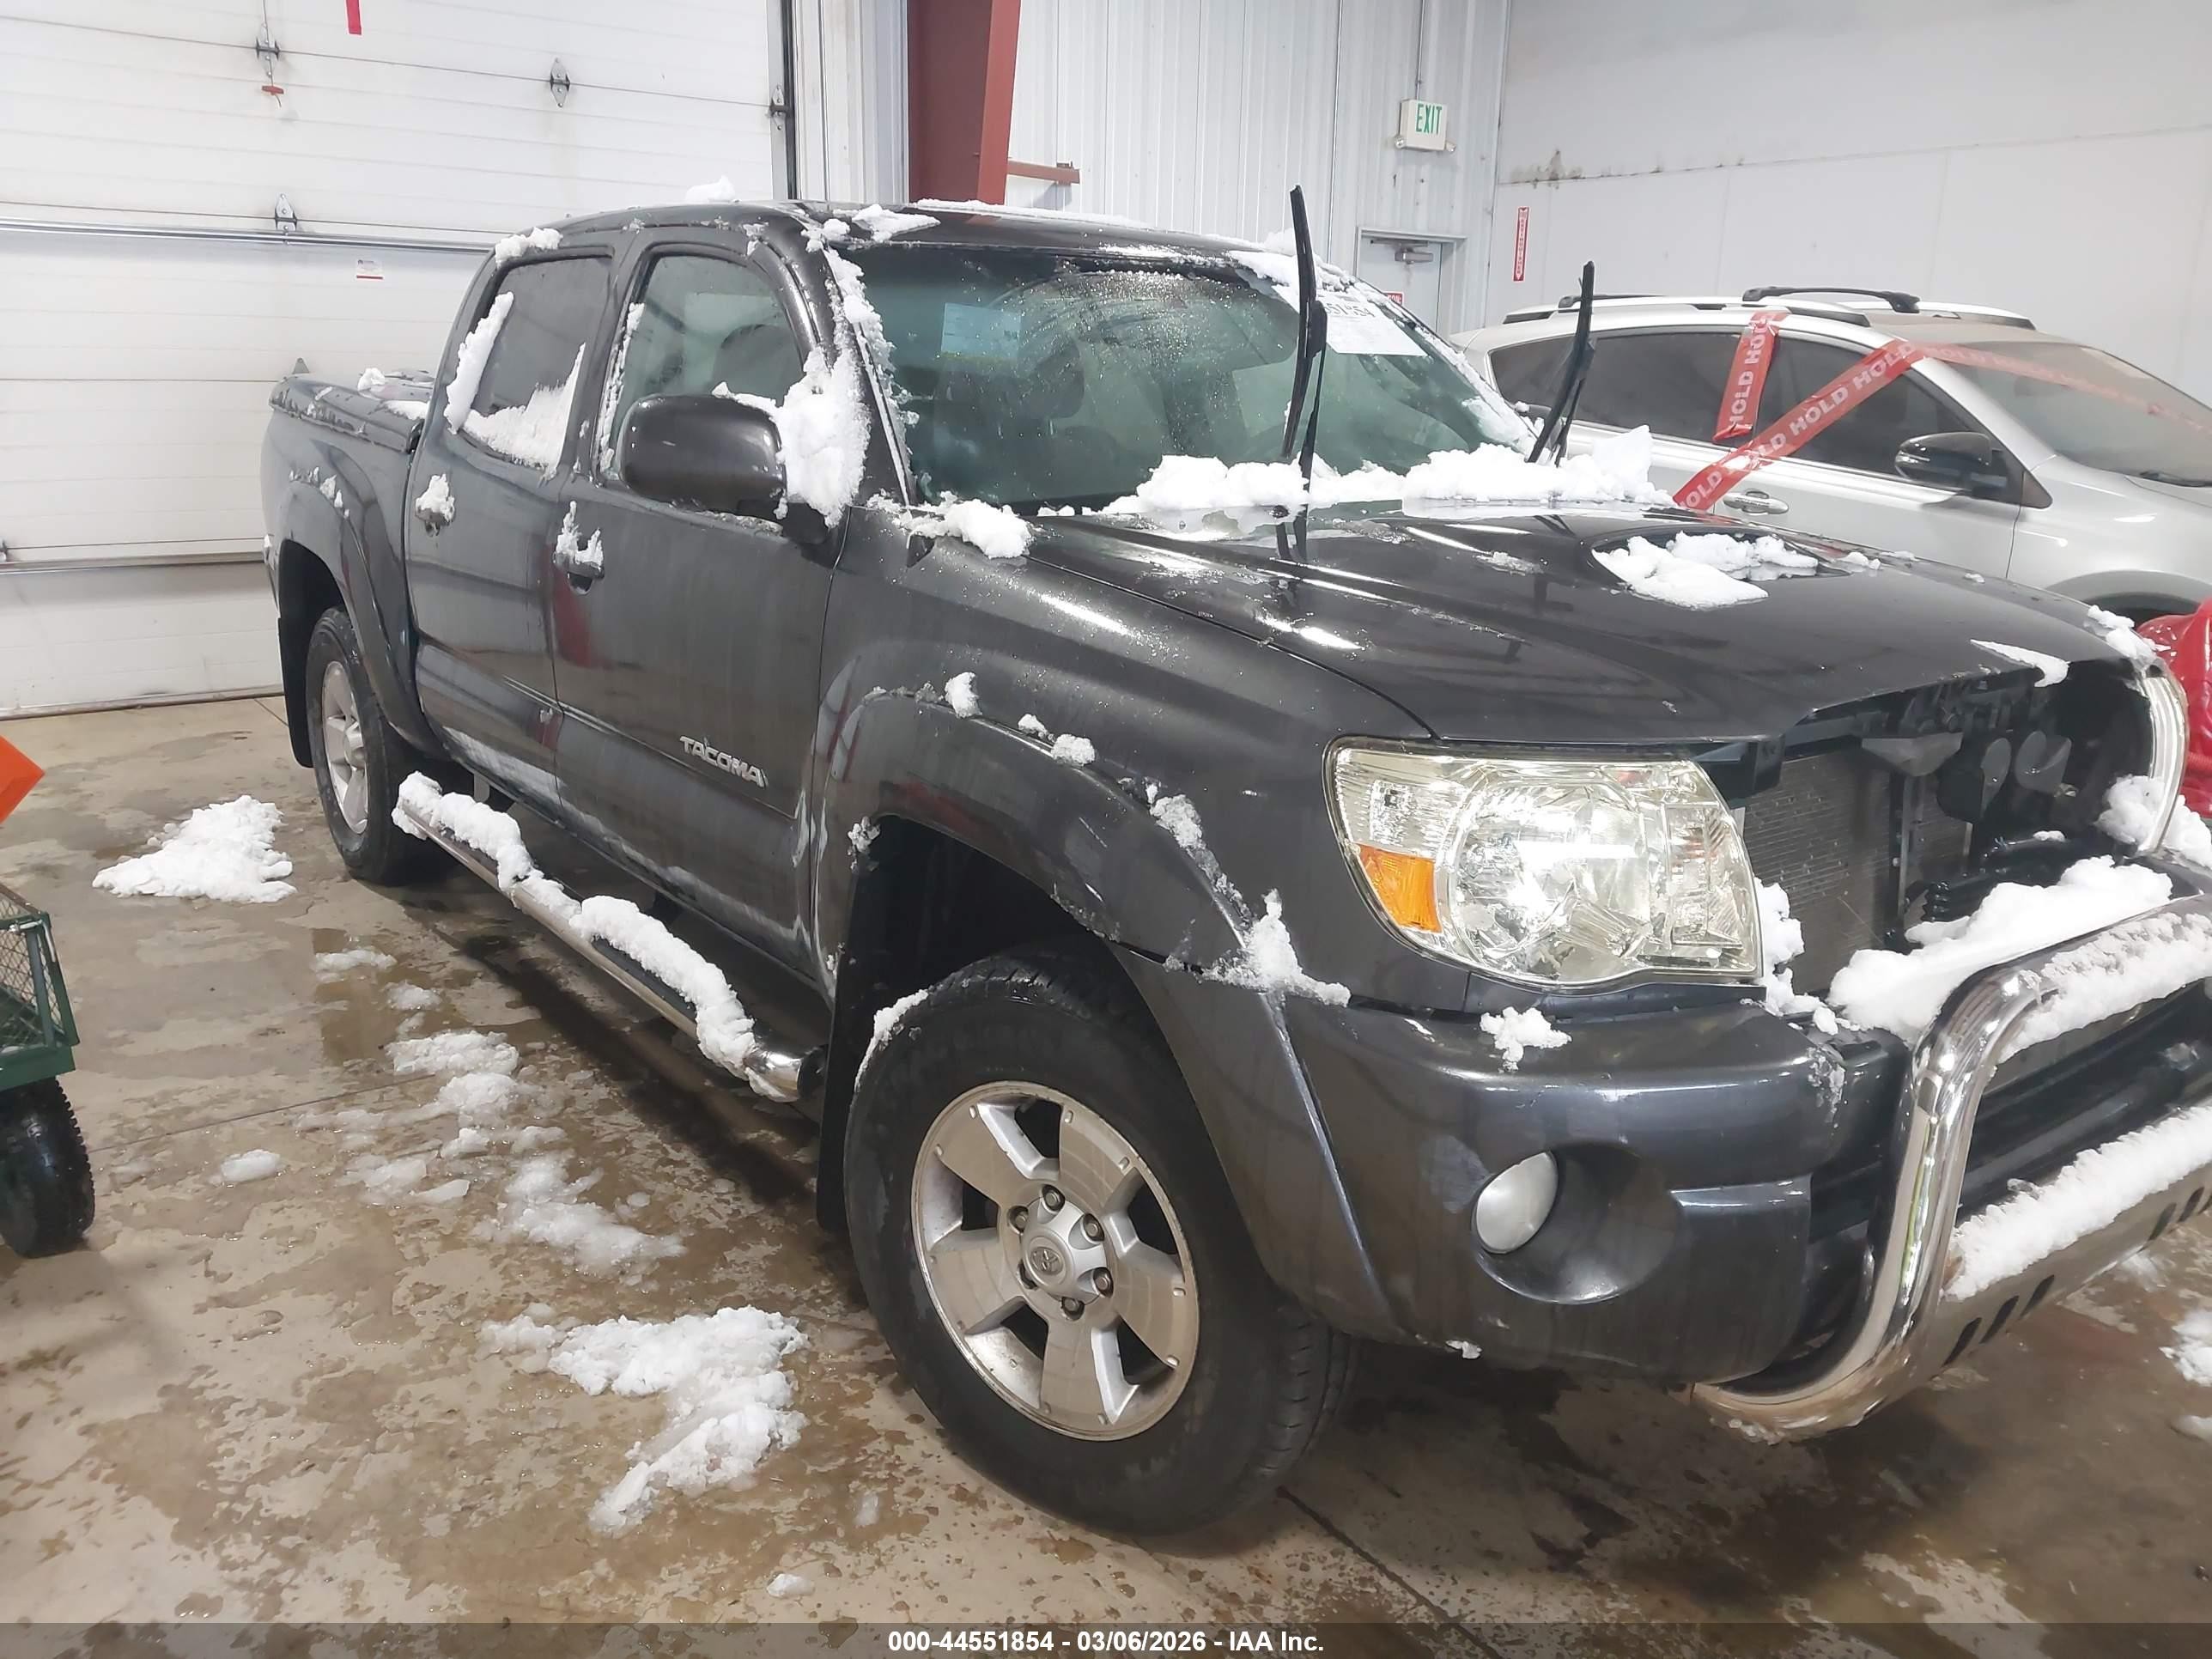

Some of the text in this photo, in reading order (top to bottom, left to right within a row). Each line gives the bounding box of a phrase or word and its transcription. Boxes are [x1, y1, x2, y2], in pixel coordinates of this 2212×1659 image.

[1416, 103, 1443, 134] EXIT
[1790, 387, 1848, 435] HOLD
[1853, 343, 1916, 390] HOLD
[679, 736, 768, 787] TACOMA
